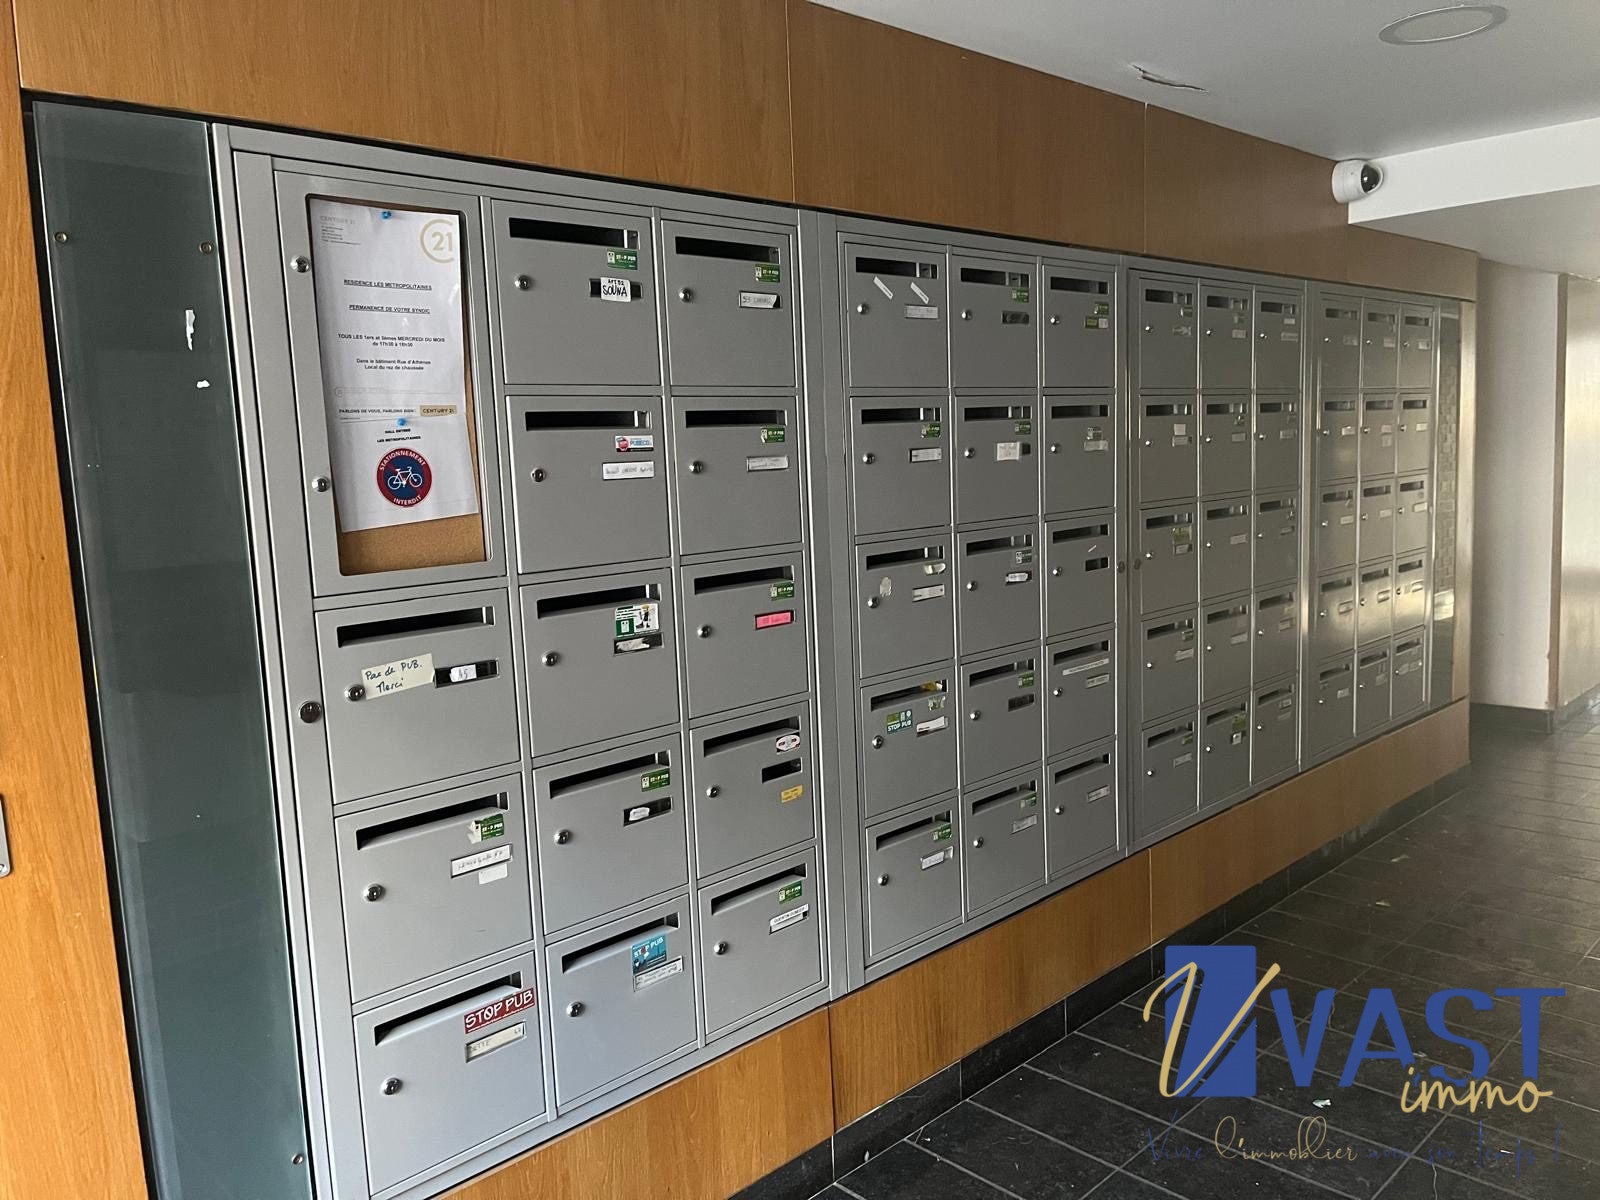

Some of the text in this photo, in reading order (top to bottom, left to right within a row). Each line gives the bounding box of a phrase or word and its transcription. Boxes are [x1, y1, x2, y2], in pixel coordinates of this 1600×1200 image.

[349, 304, 383, 312] PERMANENCE
[379, 450, 426, 470] STATIONNEMENT
[393, 495, 422, 505] INTERDIT
[384, 665, 395, 677] de
[375, 677, 404, 693] Merci
[888, 723, 901, 732] STOP
[650, 936, 664, 949] PUB
[465, 990, 533, 1029] STOP PUB
